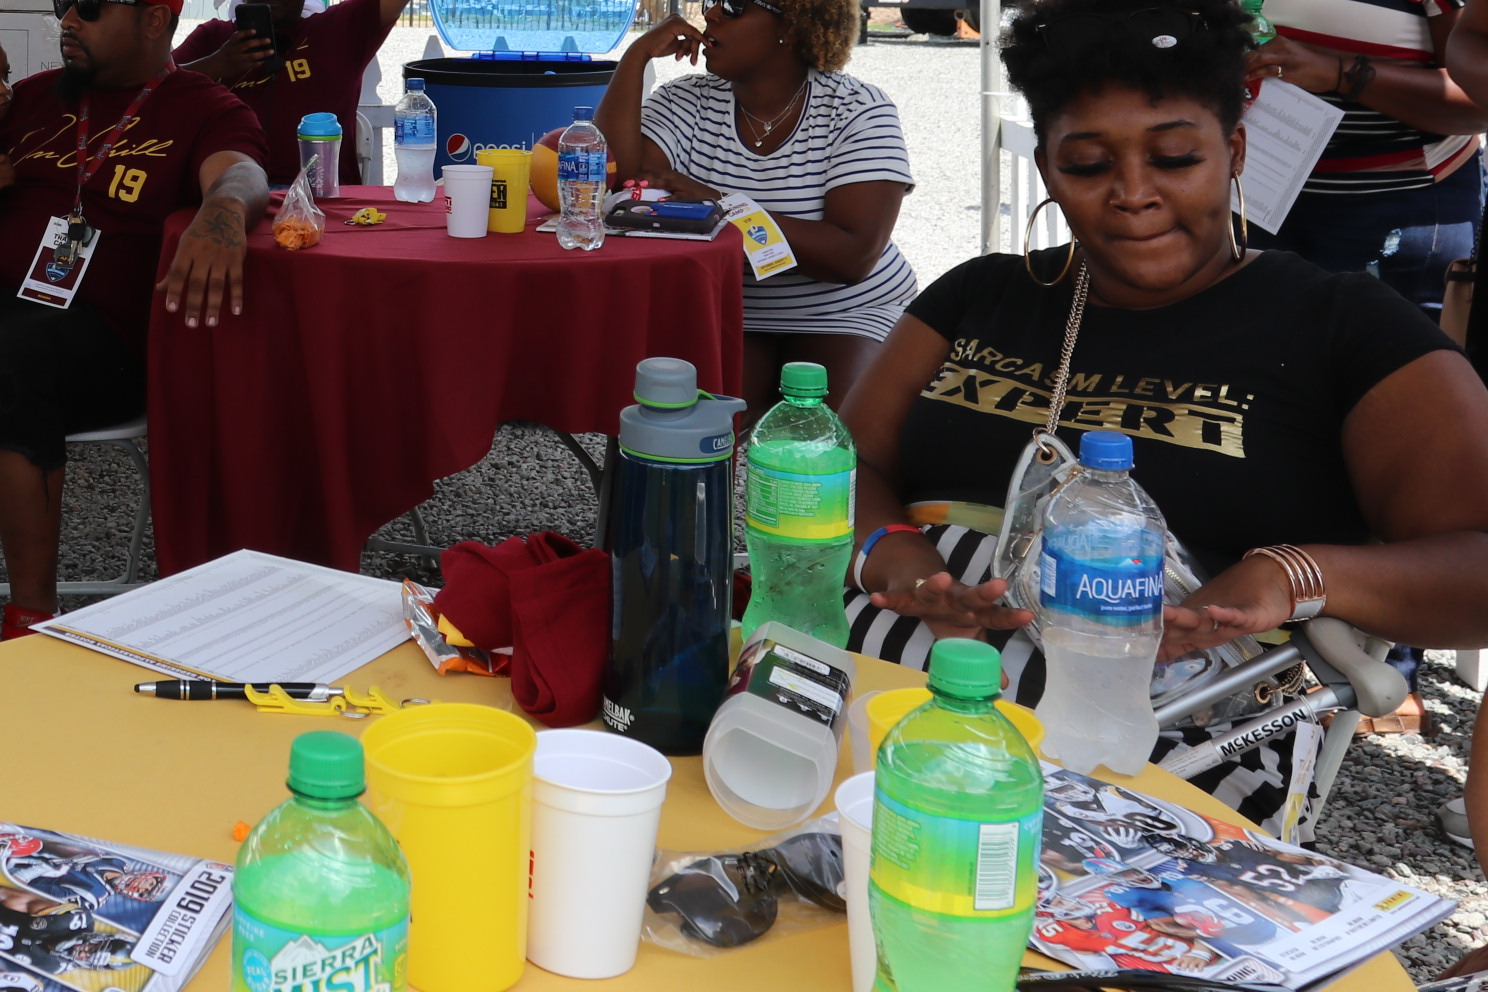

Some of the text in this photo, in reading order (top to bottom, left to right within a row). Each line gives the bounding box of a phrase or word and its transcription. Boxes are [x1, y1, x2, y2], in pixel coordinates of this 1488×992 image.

[285, 58, 311, 83] 19
[108, 165, 147, 203] 19
[950, 338, 1255, 410] SARCASM LEVEL:
[1076, 570, 1164, 603] AQUAFINA
[1219, 708, 1308, 757] McKESSON
[176, 870, 226, 915] 2019
[145, 910, 181, 959] COLLECTION
[157, 914, 196, 964] STICKER
[274, 935, 377, 985] SIERRA
